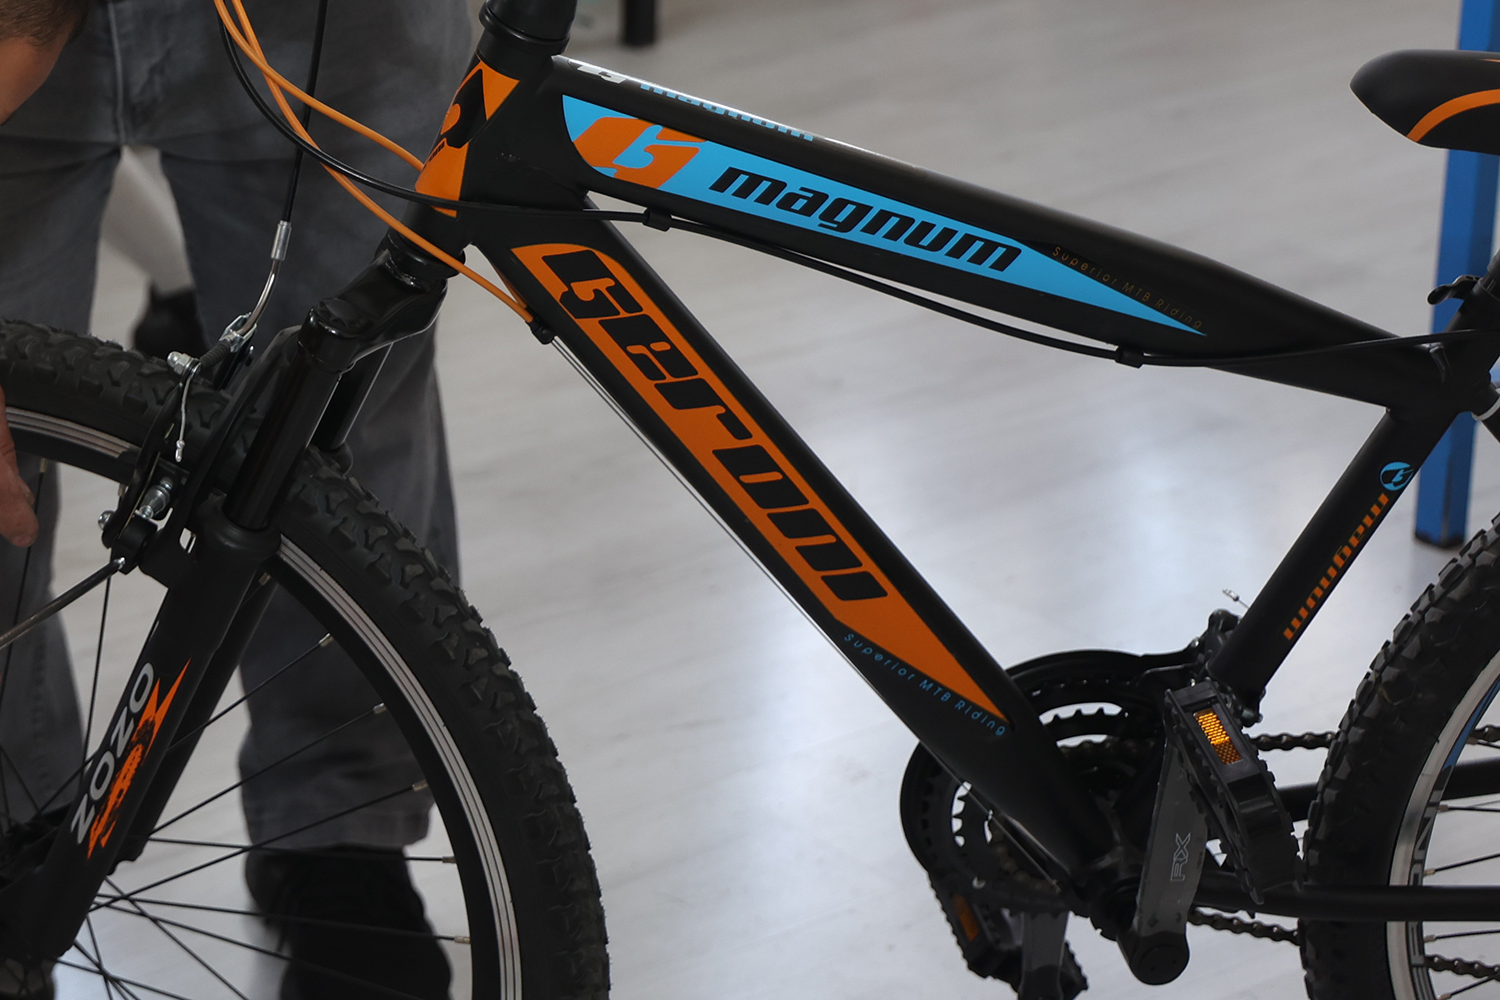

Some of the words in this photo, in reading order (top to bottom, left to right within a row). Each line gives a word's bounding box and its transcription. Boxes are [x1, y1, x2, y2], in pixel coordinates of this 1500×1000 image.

[708, 166, 1022, 273] magnum
[1052, 246, 1118, 285] Superior
[1122, 281, 1151, 302] MTB
[1155, 298, 1203, 330] Riding
[843, 632, 916, 681] Superior
[919, 679, 952, 703] MTB
[954, 700, 1006, 737] Riding
[70, 662, 155, 844] ZOZO
